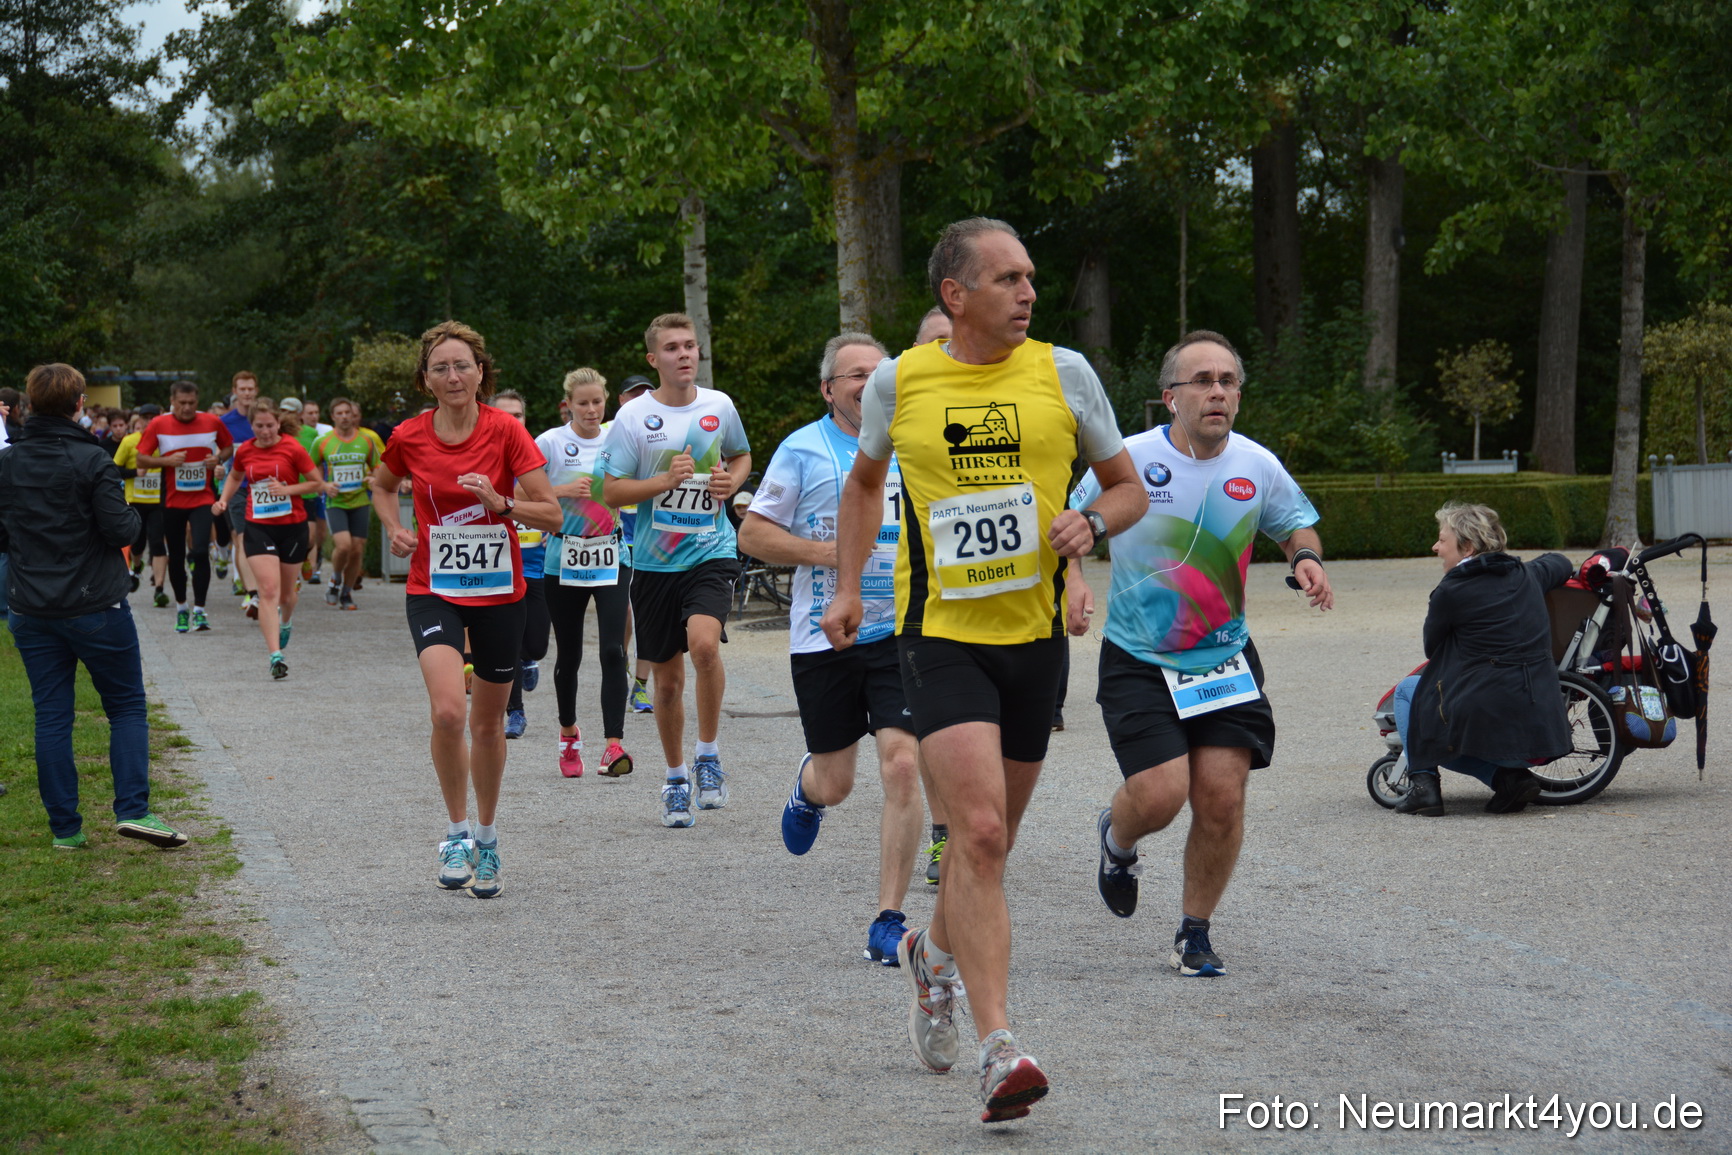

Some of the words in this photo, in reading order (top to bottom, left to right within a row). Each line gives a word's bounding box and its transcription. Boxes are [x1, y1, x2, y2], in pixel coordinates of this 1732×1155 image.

[647, 432, 668, 440] PARTL
[950, 455, 1021, 470] HIRSCH
[178, 468, 205, 480] 2095
[336, 471, 361, 481] 2714
[957, 474, 1023, 482] APOTHEKE
[141, 479, 158, 488] 186
[660, 488, 713, 511] 2778
[932, 507, 965, 520] PARTL
[966, 498, 1019, 514] Neumarkt
[454, 511, 473, 523] DEHN
[671, 515, 701, 526] Paulus
[458, 532, 497, 540] Neumarkt
[878, 530, 900, 540] ans
[954, 514, 1022, 559] 293
[564, 539, 582, 548] PARTL
[438, 543, 504, 570] 2547
[567, 547, 614, 567] 3010
[967, 562, 1016, 583] Robert
[460, 576, 484, 586] Gabi
[1215, 630, 1232, 643] 16.
[1194, 683, 1237, 700] Thomas
